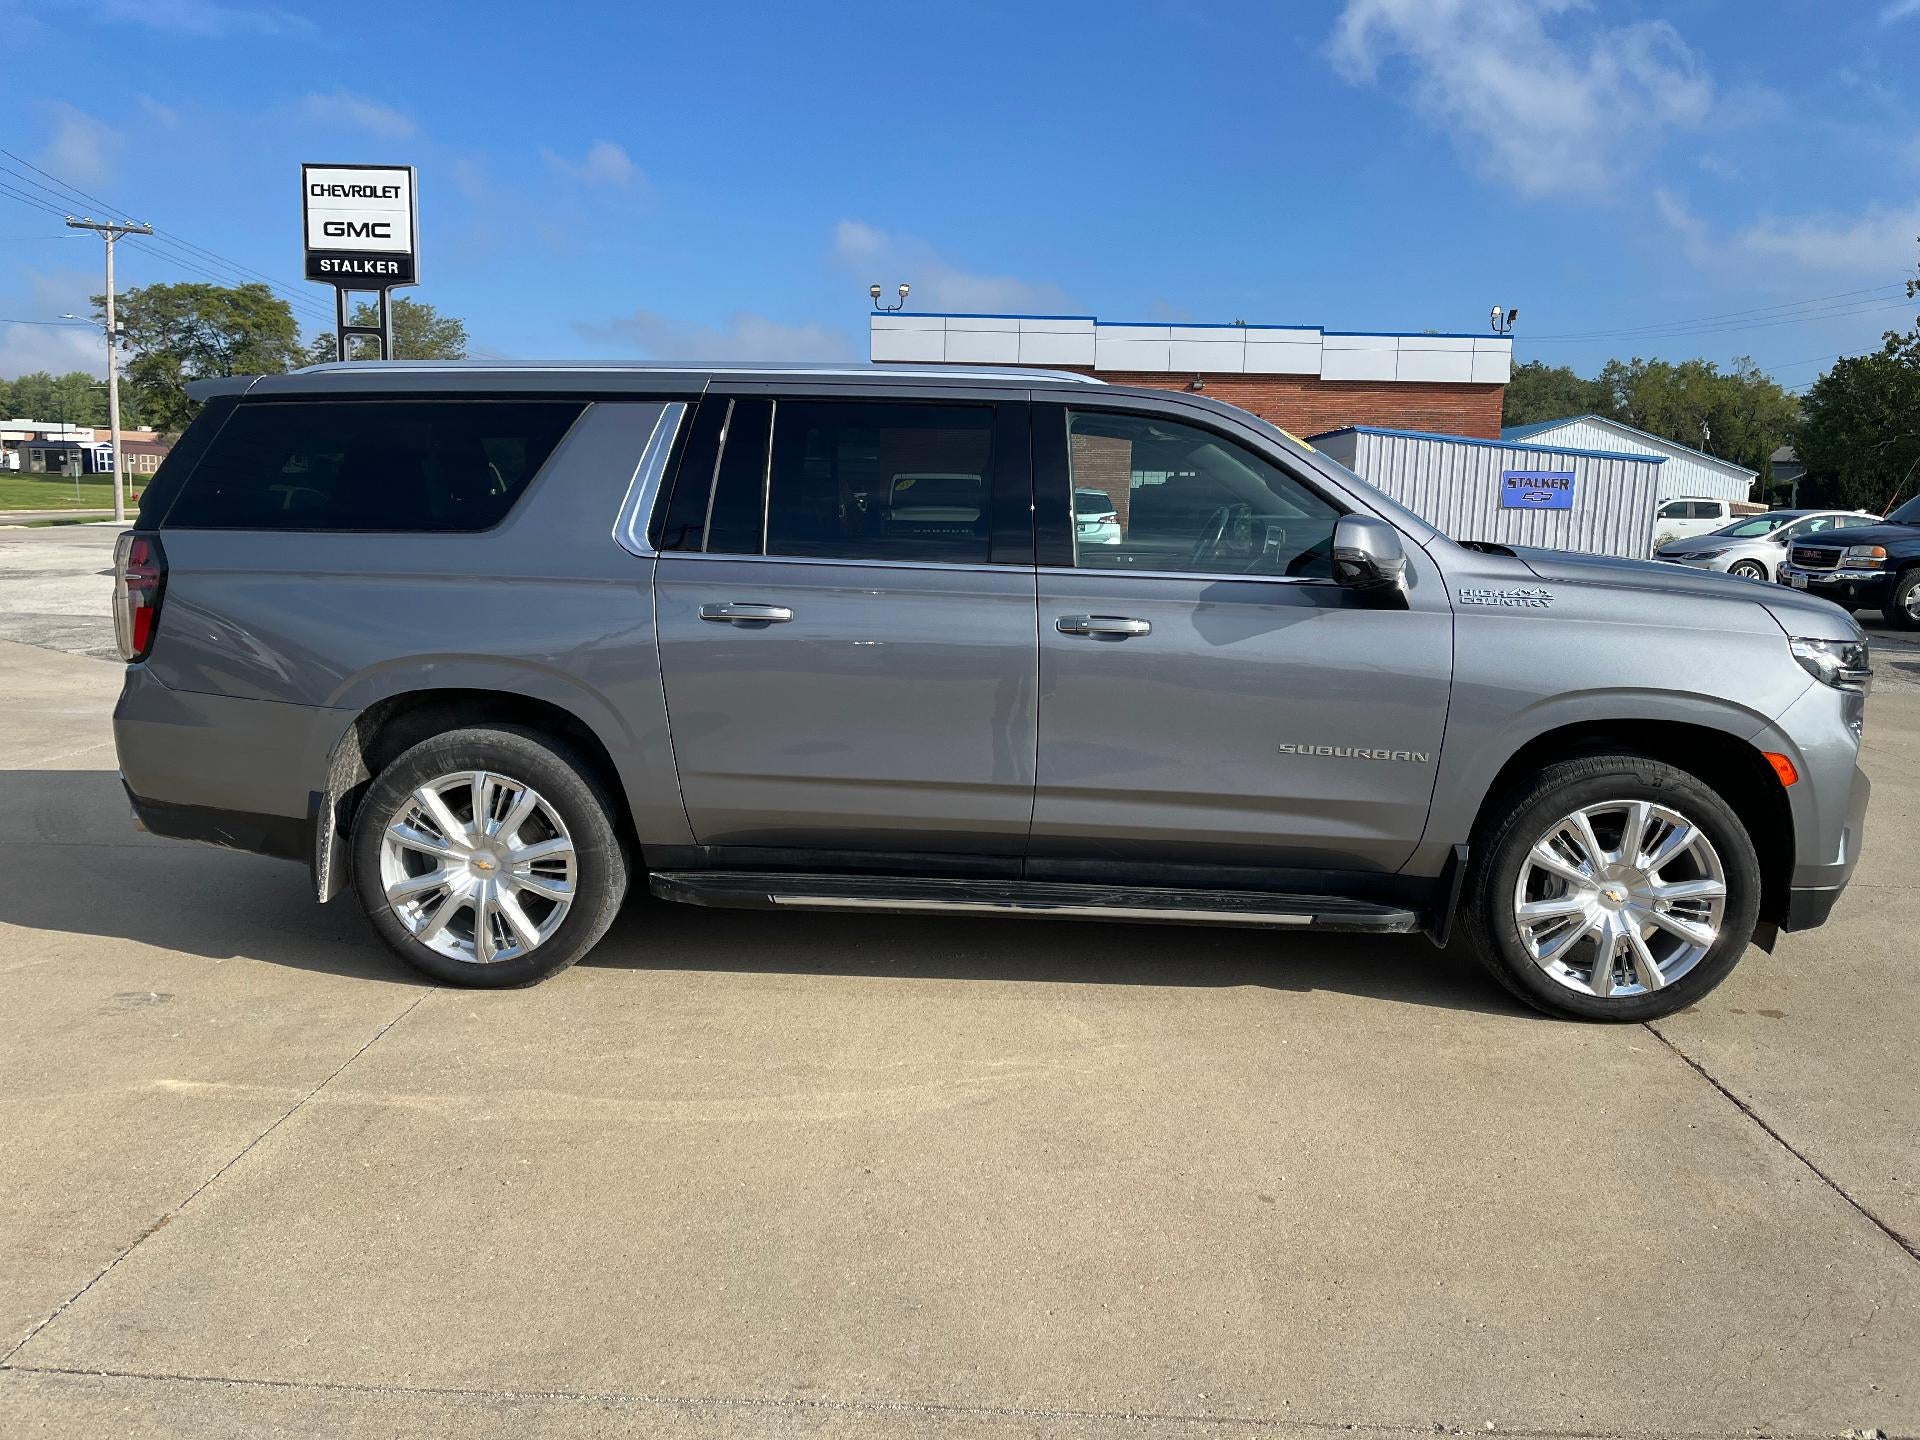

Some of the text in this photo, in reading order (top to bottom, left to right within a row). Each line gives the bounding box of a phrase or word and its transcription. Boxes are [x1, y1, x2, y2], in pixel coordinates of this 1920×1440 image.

[311, 184, 400, 199] CHEVROLET
[324, 221, 391, 238] GMC
[320, 259, 398, 273] STALKER
[1508, 477, 1570, 490] STALKER
[1459, 588, 1507, 598] HIGH
[1459, 597, 1551, 608] COUNTRY
[1279, 744, 1430, 762] SUBURBAN
